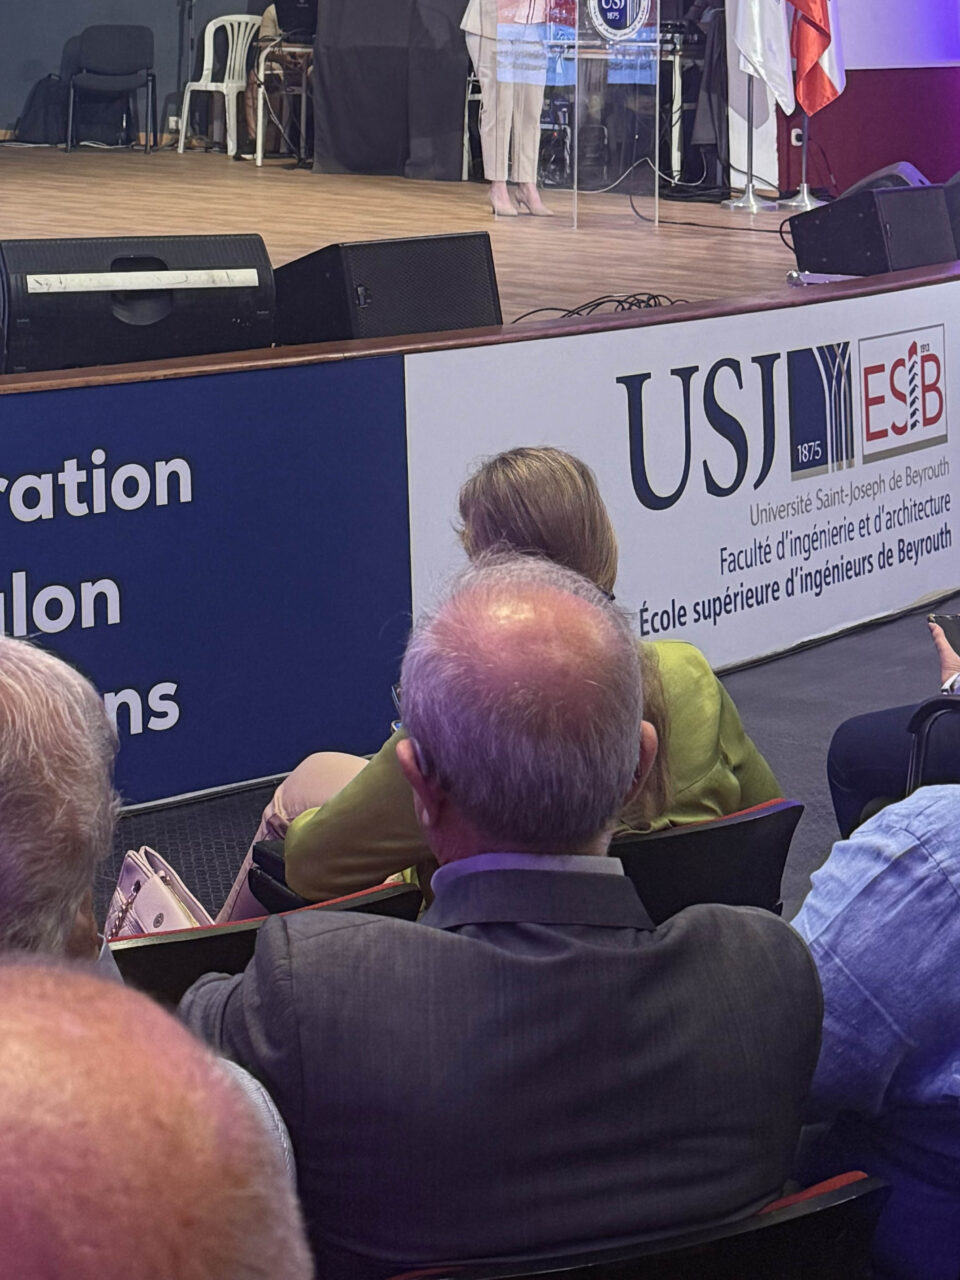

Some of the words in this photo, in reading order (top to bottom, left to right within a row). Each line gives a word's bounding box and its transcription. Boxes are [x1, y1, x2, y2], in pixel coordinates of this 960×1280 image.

[606, 11, 620, 20] 1875
[616, 352, 781, 511] USJ
[797, 440, 822, 463] 1875
[750, 492, 813, 527] Université
[816, 477, 886, 510] Saint-Joseph
[889, 471, 903, 492] de
[906, 456, 950, 489] Beyrouth
[720, 535, 772, 575] Faculté
[776, 516, 855, 562] d'ingénierie
[859, 512, 871, 538] et
[874, 492, 952, 533] d'architecture
[640, 600, 687, 637] École
[693, 579, 780, 626] supérieure
[785, 552, 875, 598] d'ingénieurs
[877, 542, 894, 570] de
[897, 522, 953, 566] Beyrouth
